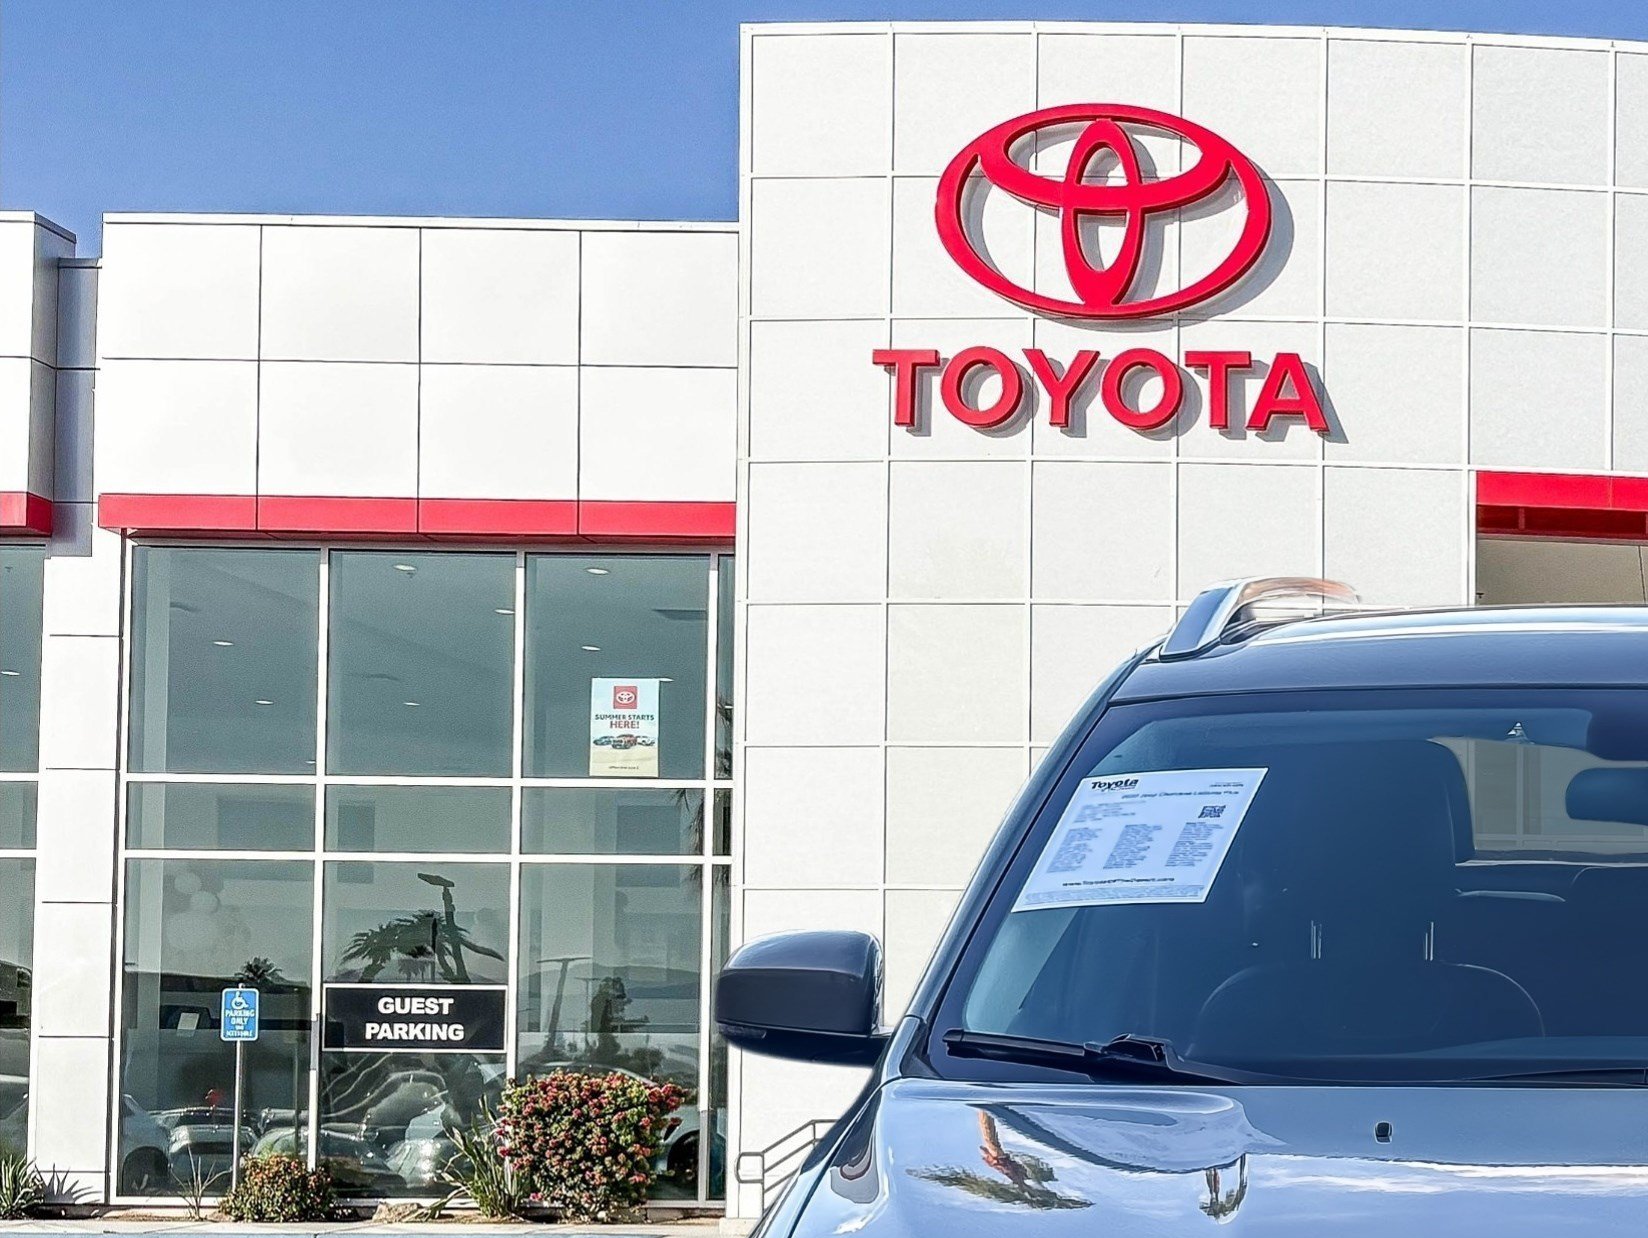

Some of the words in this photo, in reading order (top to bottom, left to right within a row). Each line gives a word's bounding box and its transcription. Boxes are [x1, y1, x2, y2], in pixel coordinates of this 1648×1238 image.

[872, 346, 1329, 434] TOYOTA
[609, 720, 640, 729] HERE!
[1091, 778, 1139, 791] Toyota
[378, 997, 454, 1015] GUEST
[365, 1022, 465, 1041] PARKING
